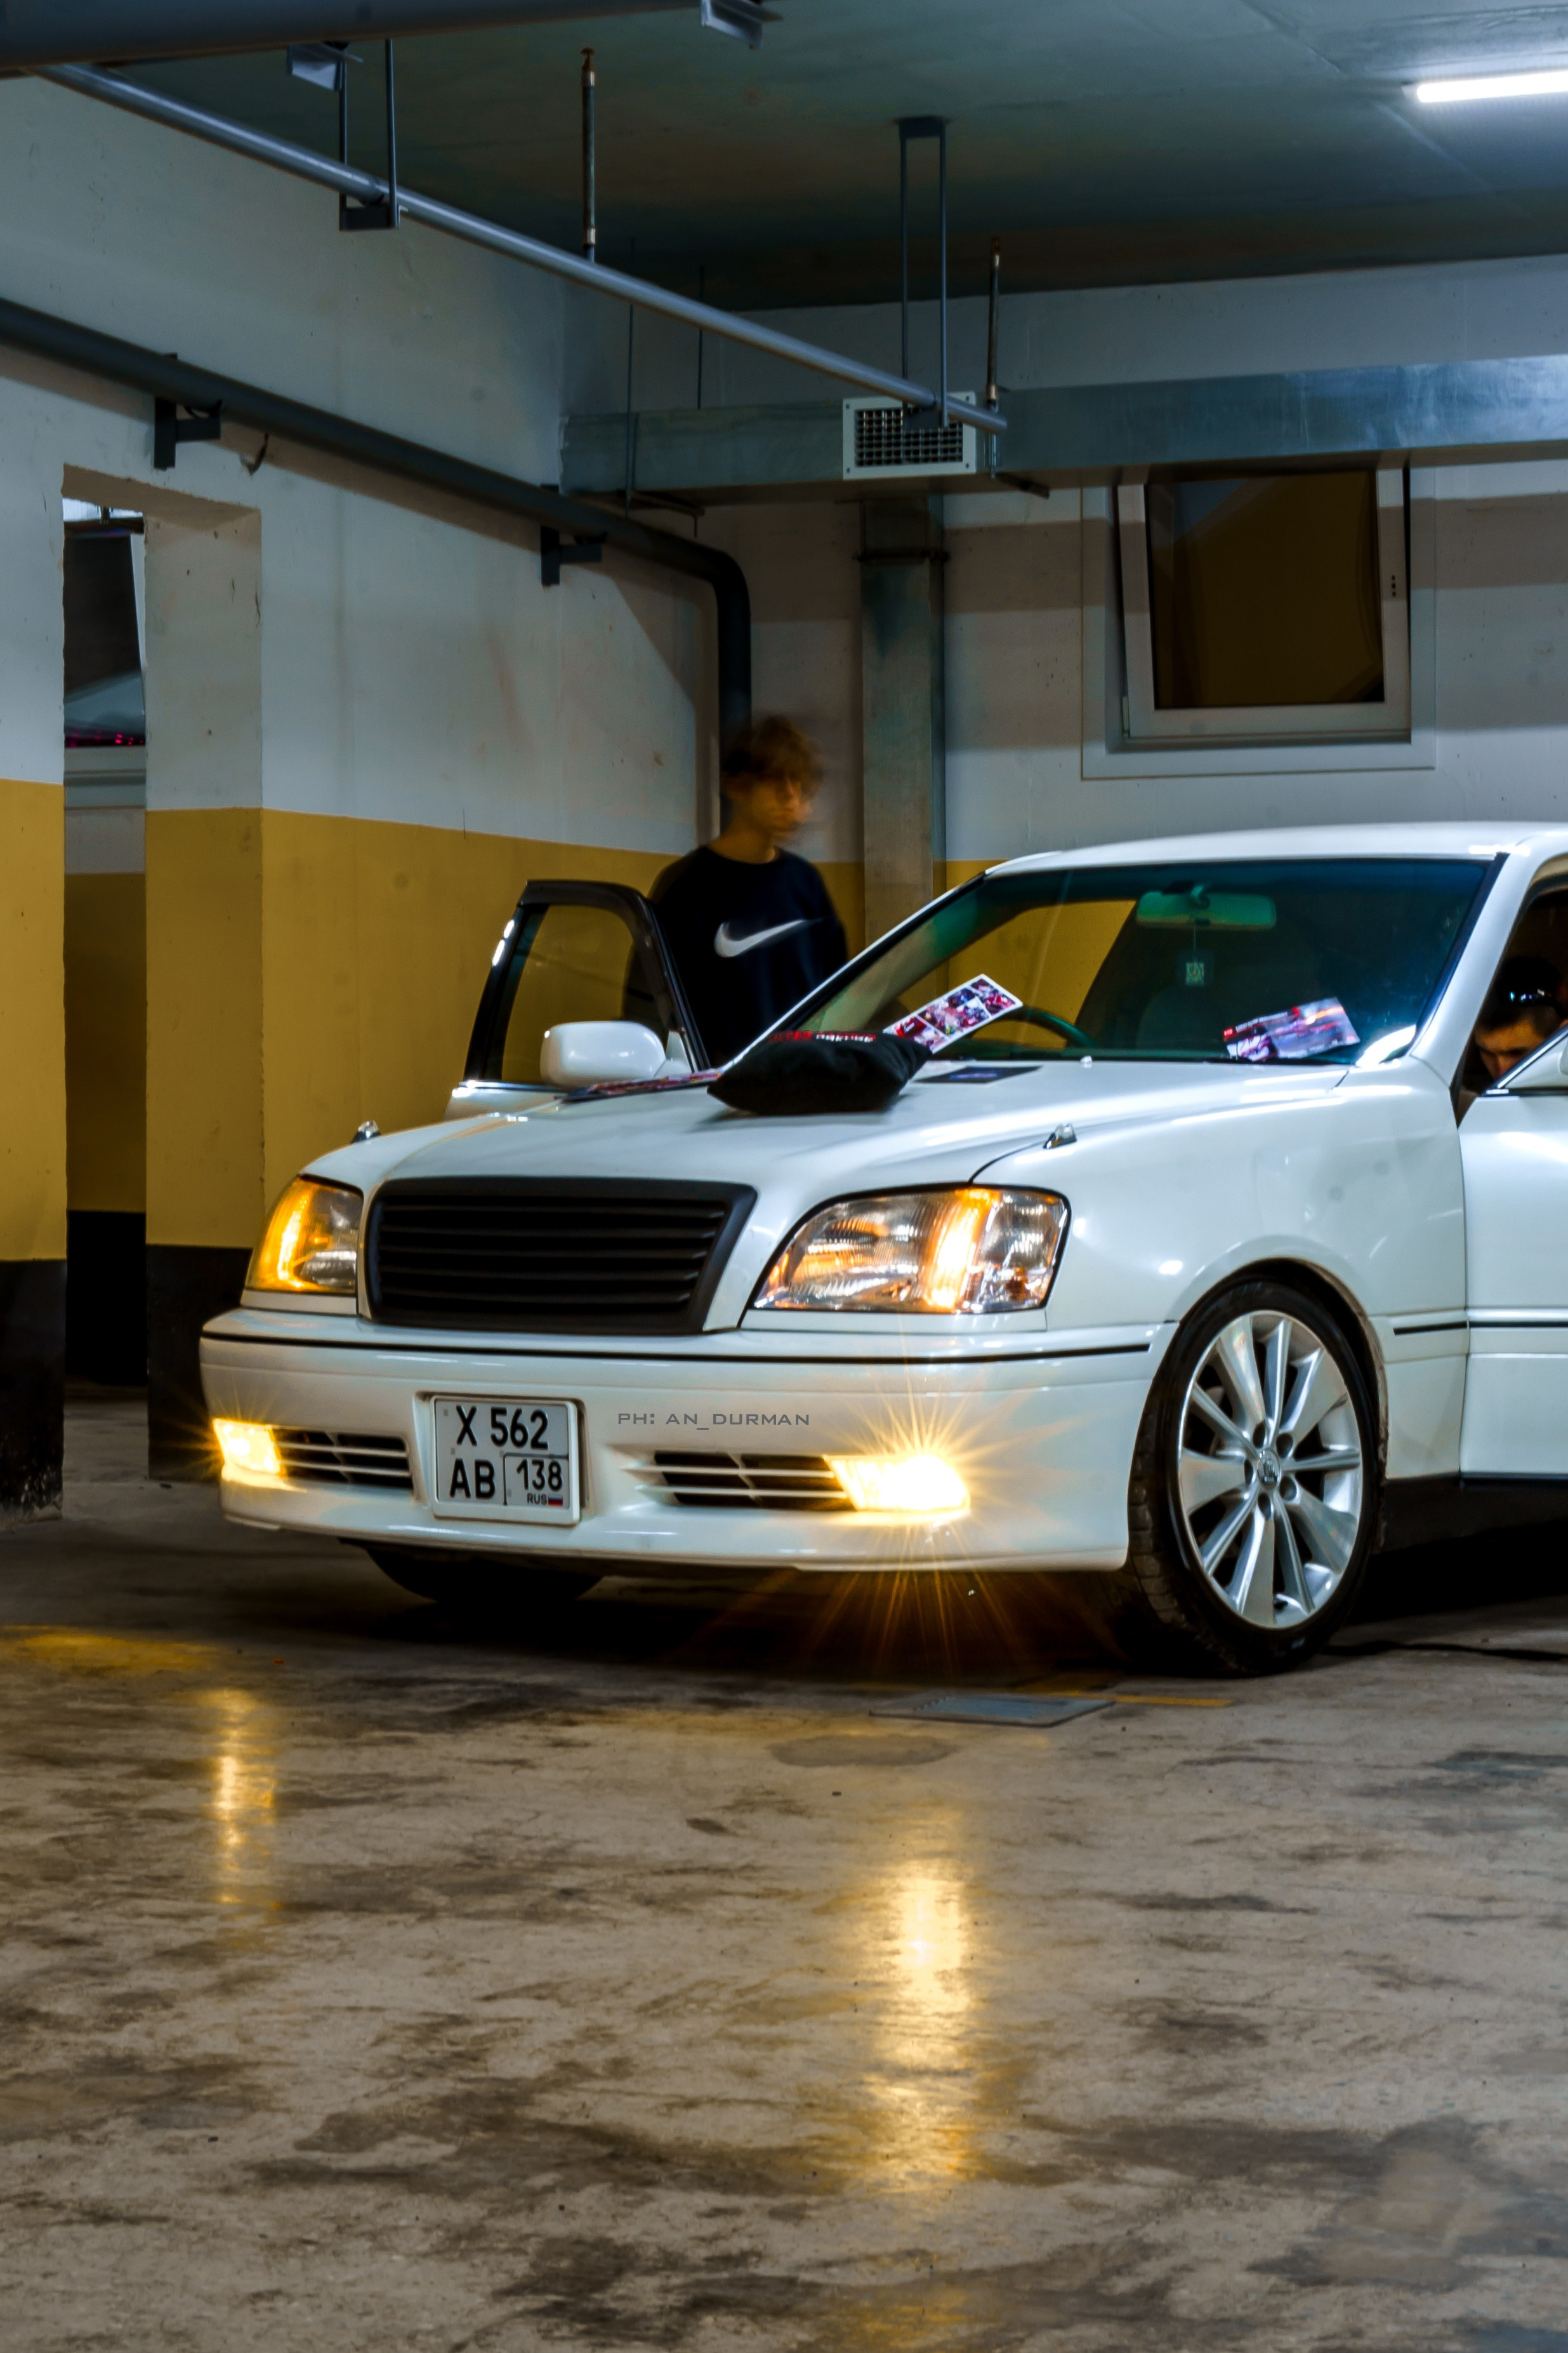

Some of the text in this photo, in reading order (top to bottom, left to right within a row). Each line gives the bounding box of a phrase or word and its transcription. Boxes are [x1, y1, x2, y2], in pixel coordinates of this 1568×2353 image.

[456, 1405, 548, 1450] X 562
[449, 1458, 496, 1499] AB
[517, 1459, 562, 1492] 138
[527, 1493, 548, 1505] RUS
